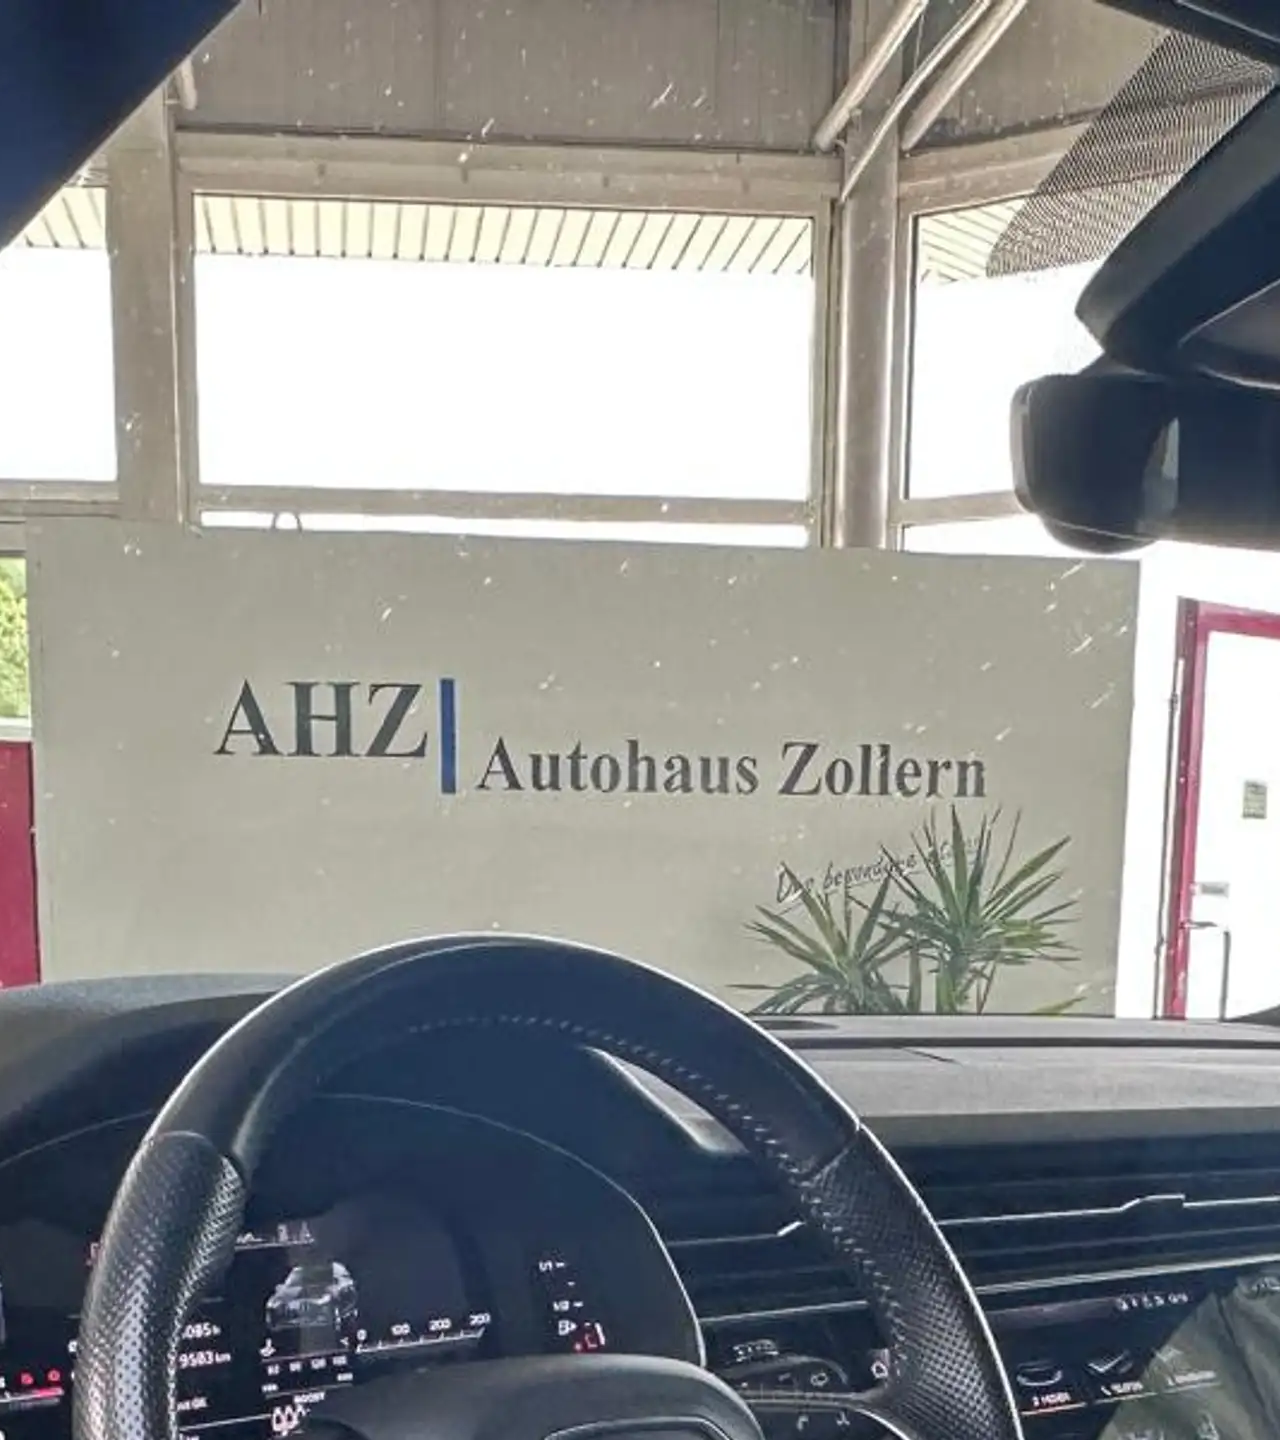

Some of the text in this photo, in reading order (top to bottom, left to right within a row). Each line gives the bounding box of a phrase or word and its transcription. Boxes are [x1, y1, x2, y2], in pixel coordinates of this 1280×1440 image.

[212, 678, 429, 758] AHZ
[475, 737, 987, 798] Autohaus Zollern
